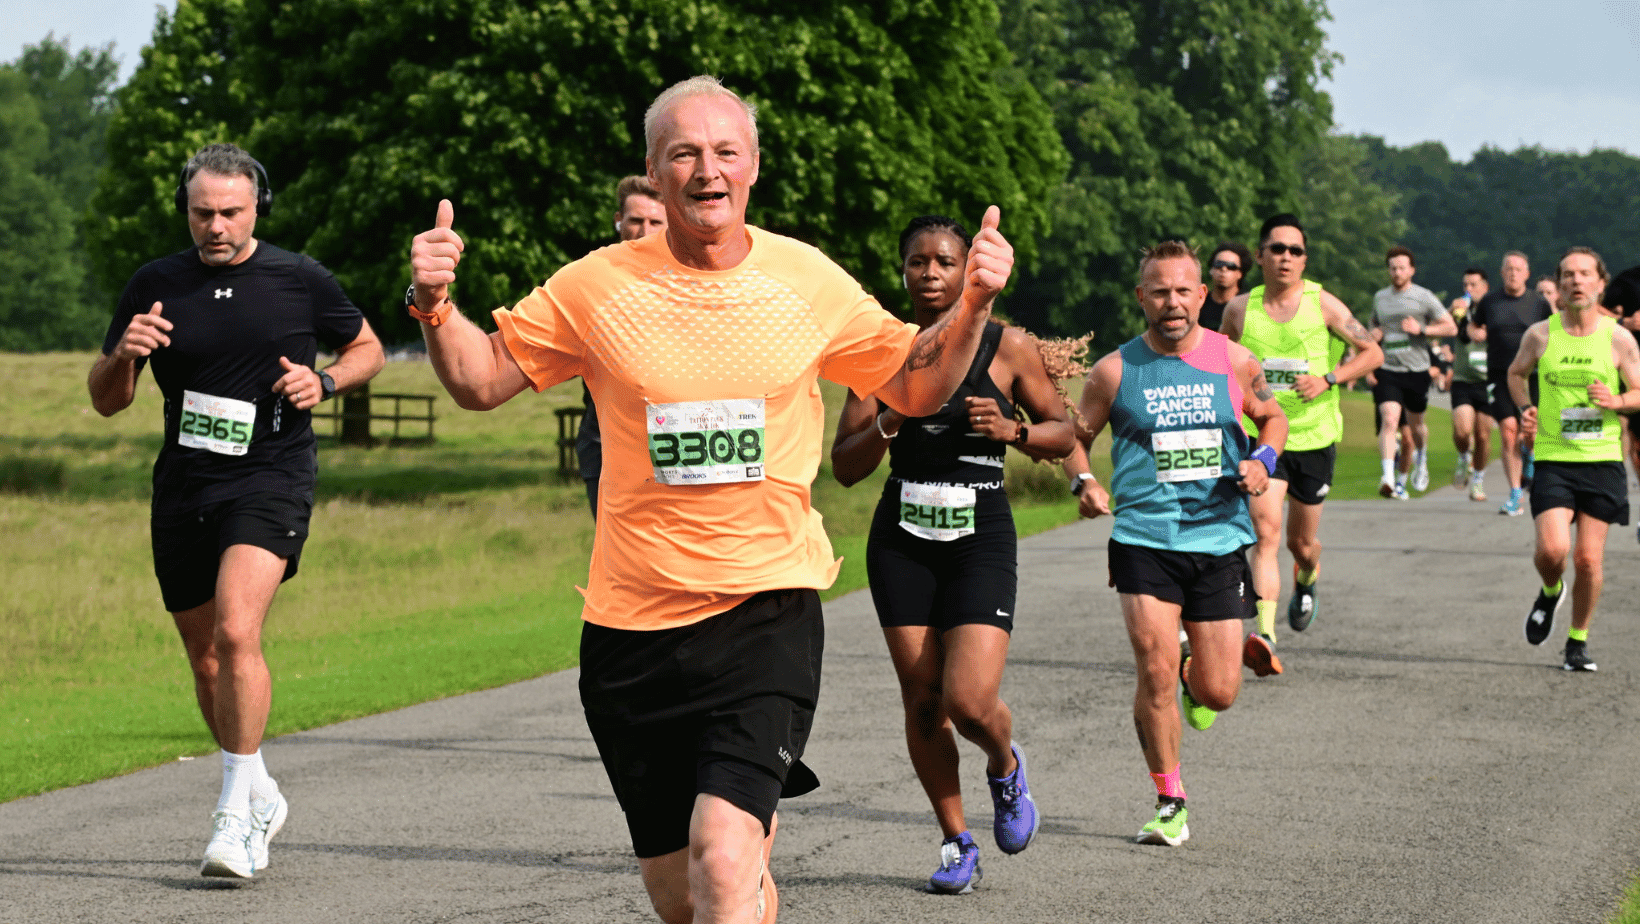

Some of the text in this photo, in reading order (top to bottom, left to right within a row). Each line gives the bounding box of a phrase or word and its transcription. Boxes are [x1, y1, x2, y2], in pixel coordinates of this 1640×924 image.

[1559, 356, 1592, 364] Alan
[1264, 370, 1308, 384] 276
[1143, 383, 1214, 401] OVARIAN
[1146, 397, 1212, 415] CANCER
[181, 410, 249, 444] 2365
[1155, 410, 1216, 427] ACTION
[652, 428, 762, 467] 3308
[1156, 447, 1219, 471] 3252
[903, 503, 970, 529] 2415
